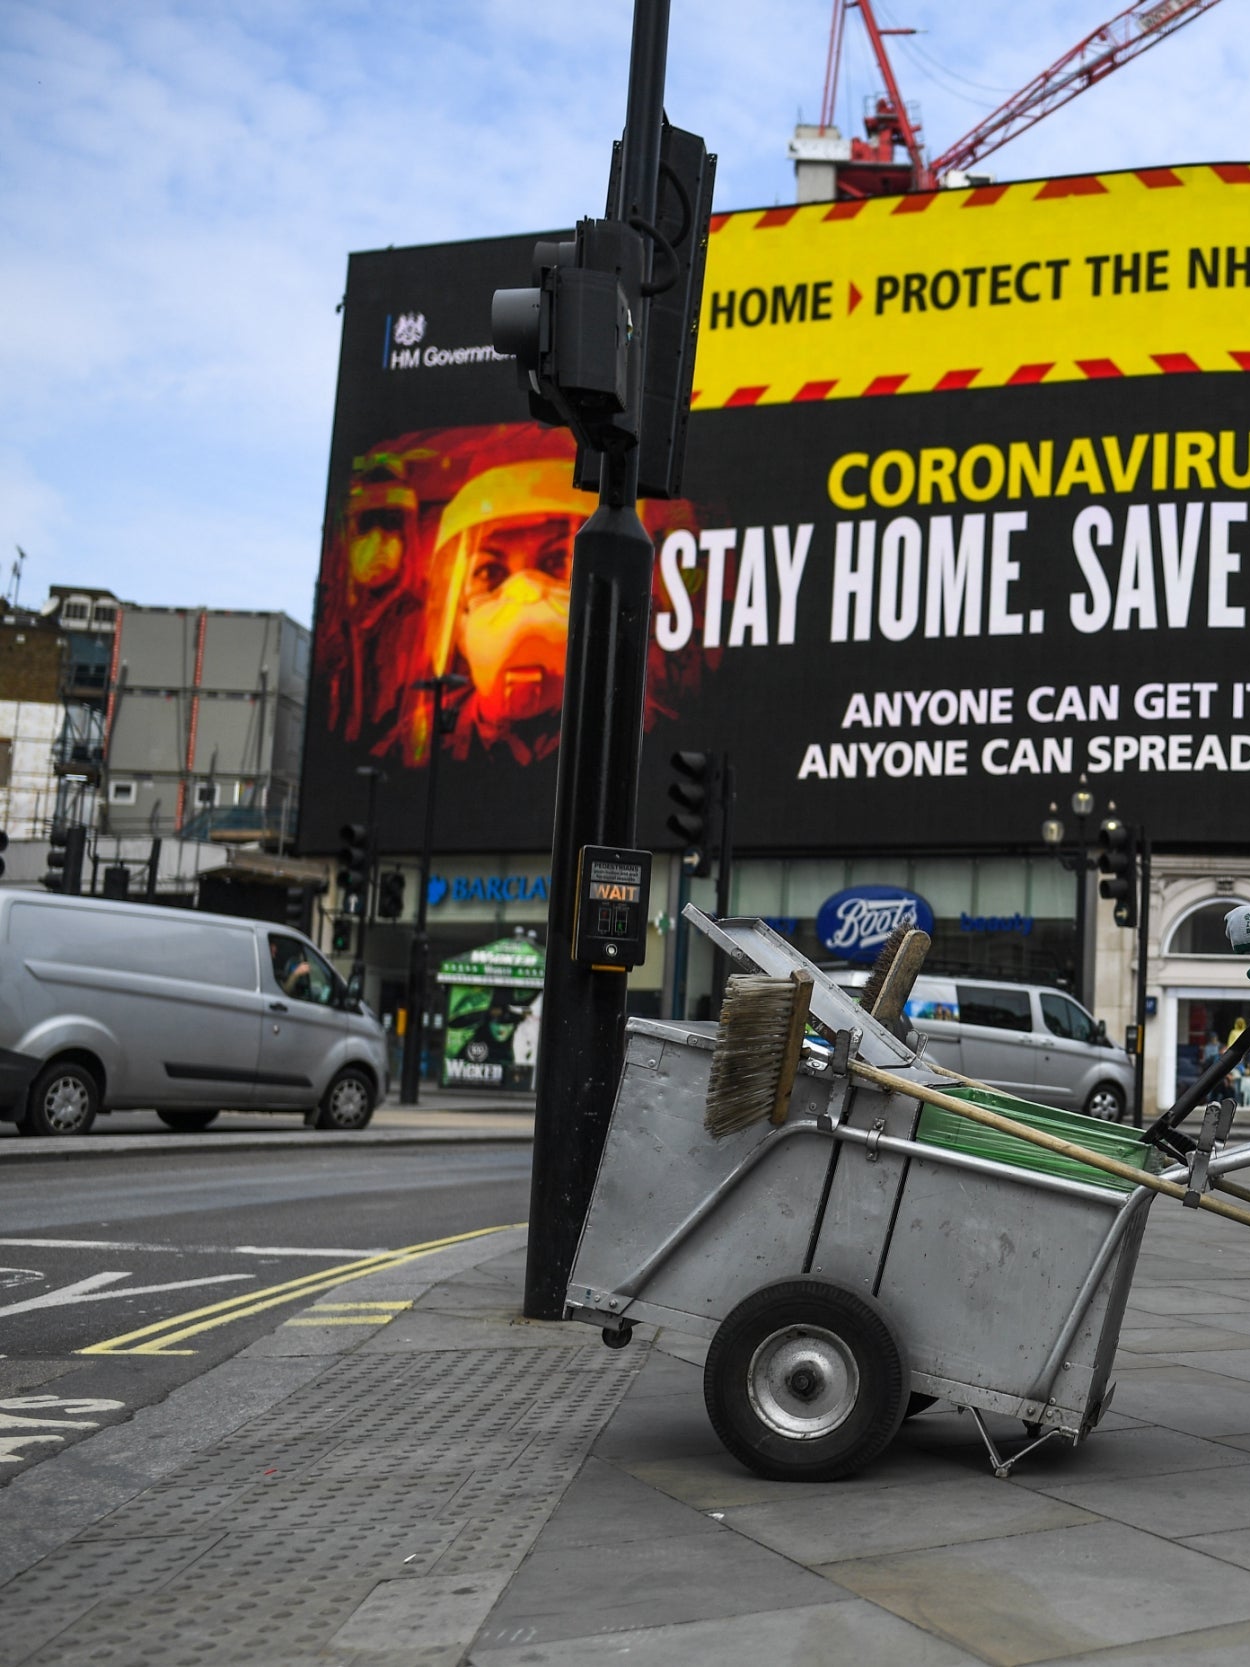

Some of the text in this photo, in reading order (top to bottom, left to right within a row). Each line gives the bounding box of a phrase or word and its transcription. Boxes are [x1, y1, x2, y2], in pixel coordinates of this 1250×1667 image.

[709, 280, 834, 330] HOME
[874, 258, 1071, 316] PROTECT
[1084, 249, 1170, 297] THE
[390, 345, 517, 370] HM Governm
[655, 523, 814, 652] STAY
[830, 510, 1044, 643] HOME.
[1069, 501, 1248, 634] SAVE
[841, 687, 1014, 729] ANYONE
[1027, 684, 1119, 723] CAN
[1134, 682, 1218, 720] GET
[798, 739, 968, 780] ANYONE
[981, 737, 1073, 775] CAN
[451, 876, 551, 901] BARCLA
[593, 883, 638, 901] WAIT
[826, 898, 917, 948] Boots
[960, 913, 1034, 935] beauty
